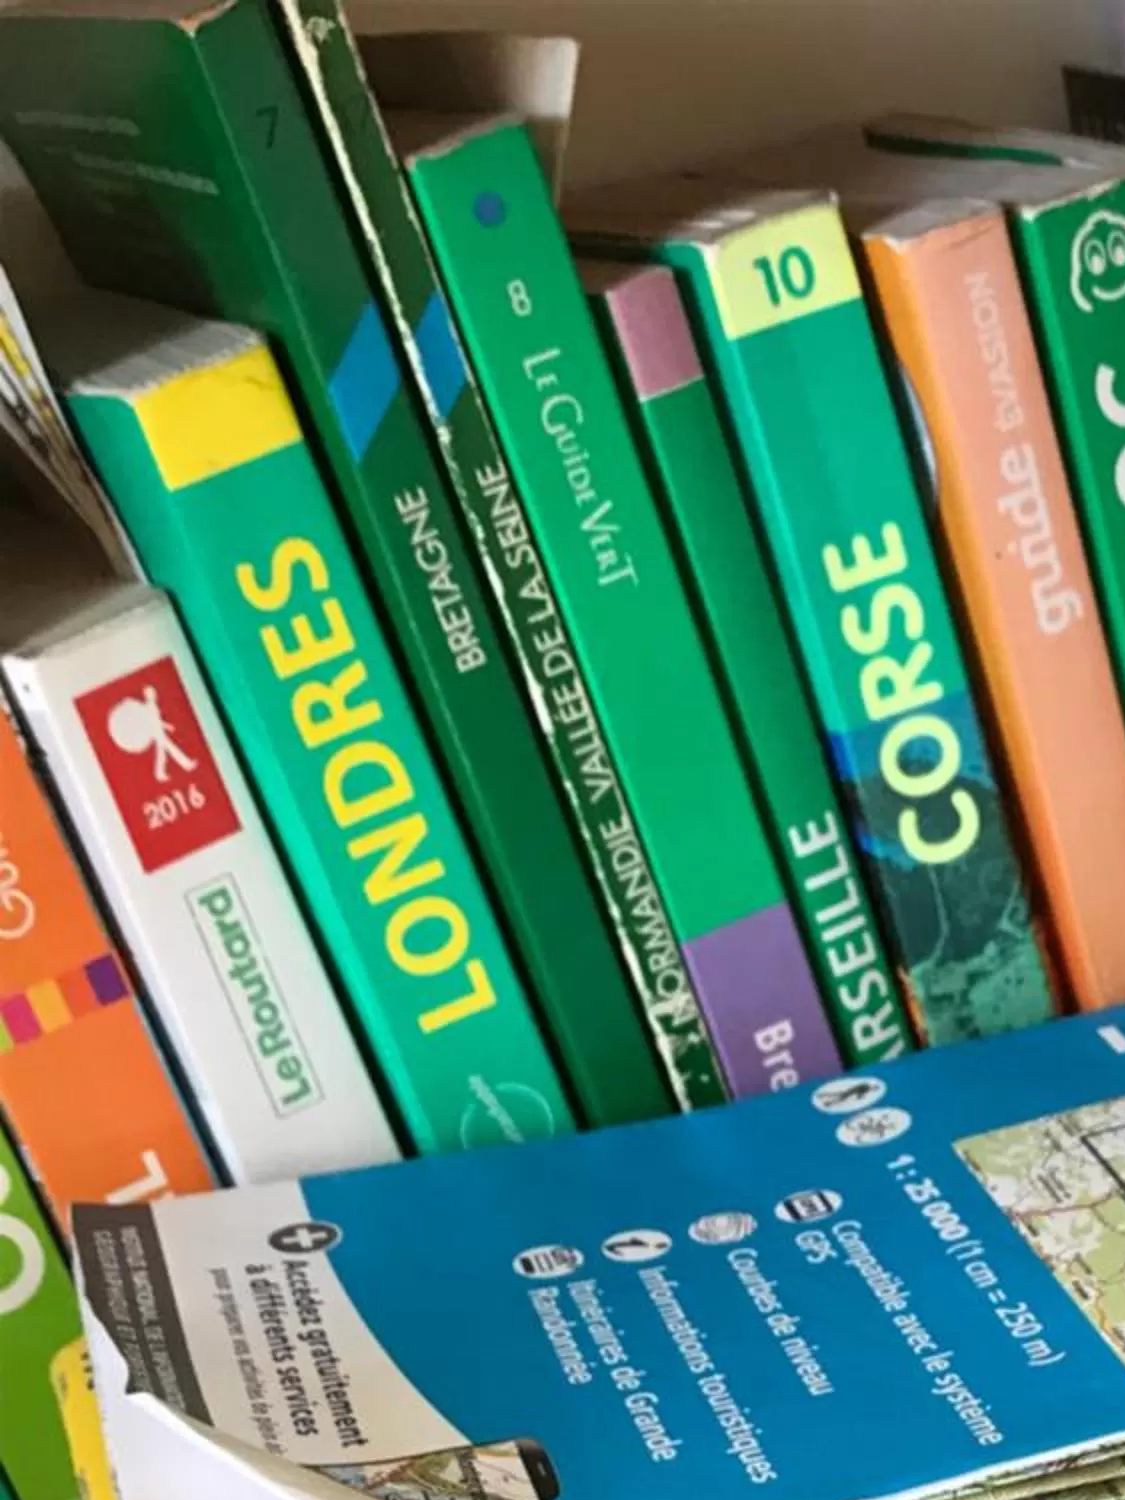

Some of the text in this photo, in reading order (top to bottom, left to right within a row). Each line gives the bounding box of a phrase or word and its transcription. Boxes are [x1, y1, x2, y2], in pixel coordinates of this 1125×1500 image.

[507, 281, 531, 317] 8
[753, 243, 816, 308] 10
[394, 487, 488, 673] BRETAGNE
[998, 442, 1083, 636] guide
[476, 461, 702, 1032] NORMANDIE VALLÉE DE LA SEINE
[822, 521, 980, 865] CORSE
[142, 783, 207, 830] 2016
[236, 537, 498, 1035] LONDRES
[727, 1248, 835, 1397] Courbes de niveau
[795, 1229, 838, 1264] GPS
[994, 1301, 1043, 1339] 250
[250, 1279, 297, 1363] différents
[276, 1366, 319, 1437] services
[283, 1260, 368, 1448] Accédez gratuitement
[527, 1285, 599, 1386] Randonnée
[610, 1365, 647, 1391] de
[637, 1266, 779, 1484] Informations touristiques
[831, 1219, 1004, 1447] Compatible avec le système
[624, 1391, 684, 1463] Grande
